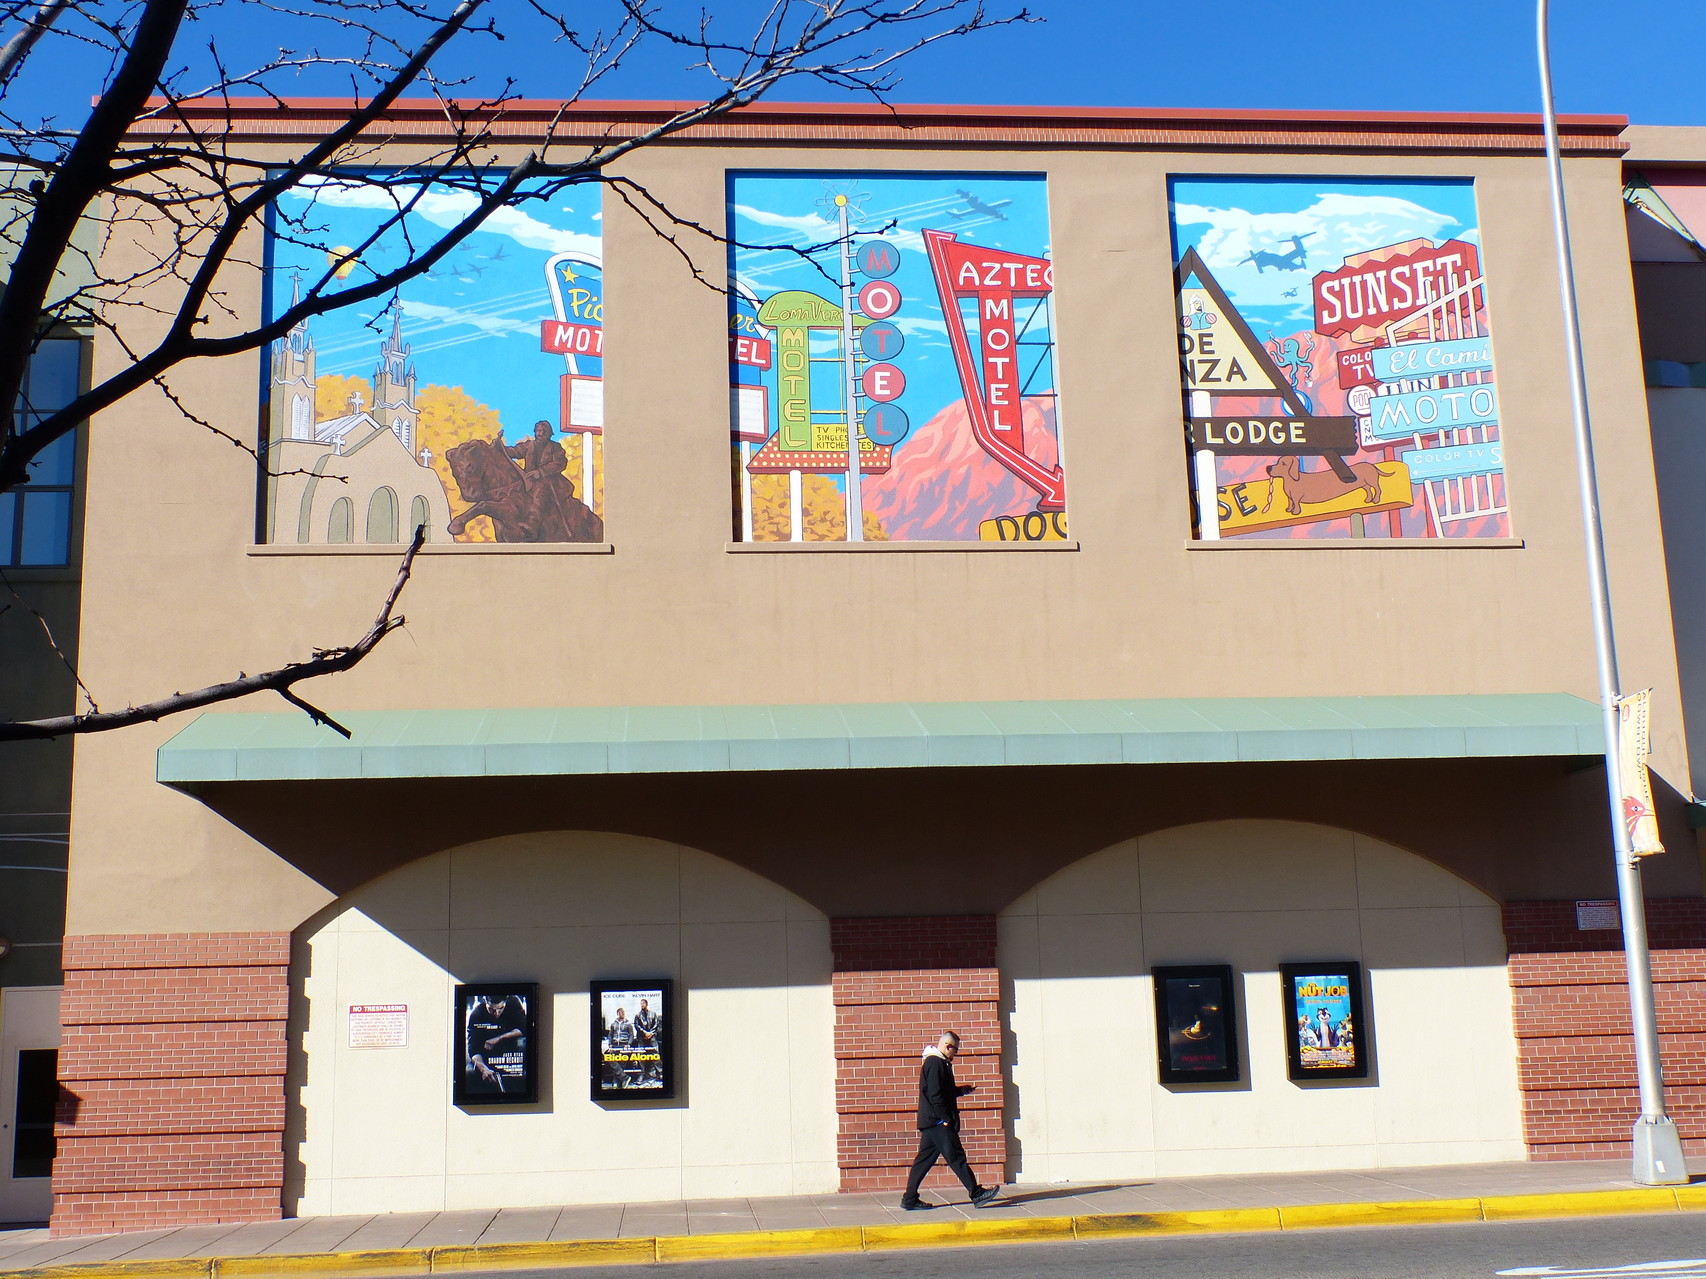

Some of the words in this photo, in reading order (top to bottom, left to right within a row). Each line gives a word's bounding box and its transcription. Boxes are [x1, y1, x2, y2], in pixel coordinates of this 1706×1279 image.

[1321, 253, 1462, 325] SUNSET
[866, 249, 892, 436] MOTEL
[985, 298, 1012, 431] MOTEL
[1390, 349, 1418, 373] El
[1425, 344, 1492, 367] Cami
[782, 327, 807, 447] MOTEL
[1378, 388, 1494, 430] MOTO
[1205, 421, 1307, 444] LODGE
[1413, 451, 1462, 464] COLOR
[1467, 449, 1484, 458] TV
